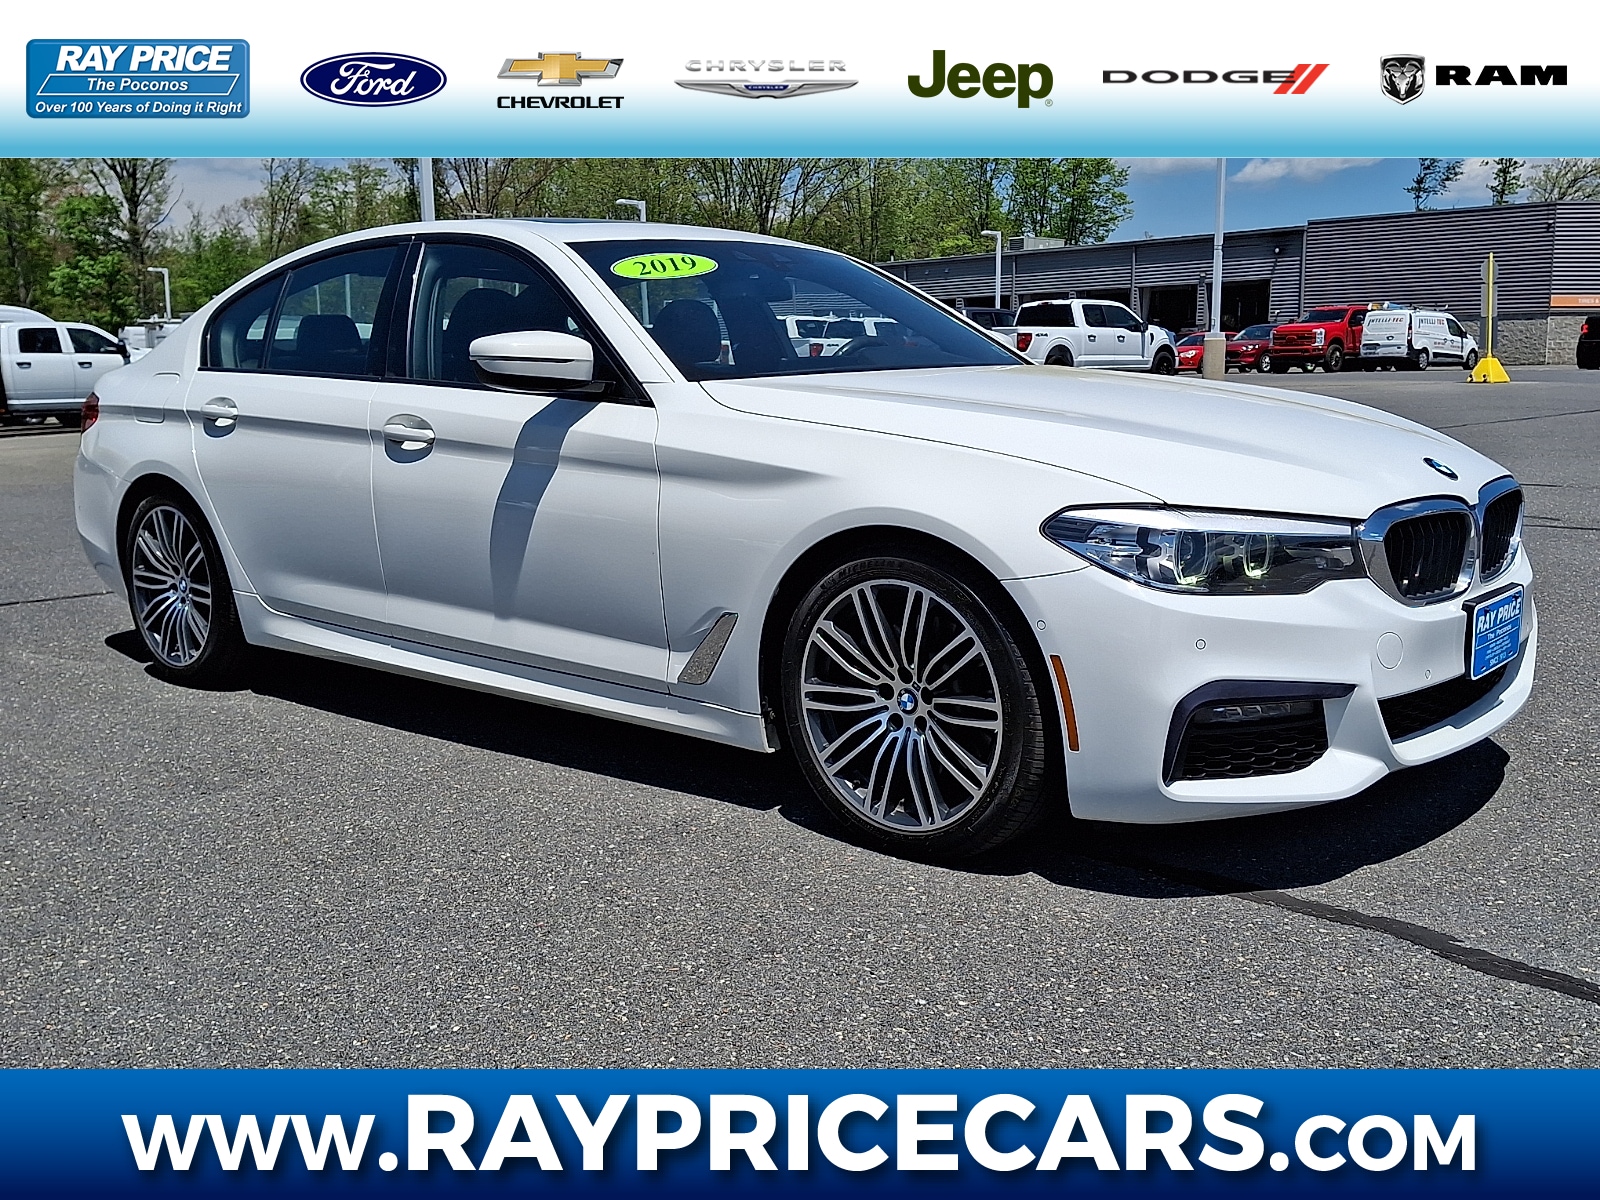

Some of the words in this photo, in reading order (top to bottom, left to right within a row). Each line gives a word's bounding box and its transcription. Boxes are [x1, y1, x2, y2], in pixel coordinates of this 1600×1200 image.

[634, 255, 698, 277] 2019
[1477, 609, 1497, 634] RAY
[1497, 598, 1521, 625] PRICE
